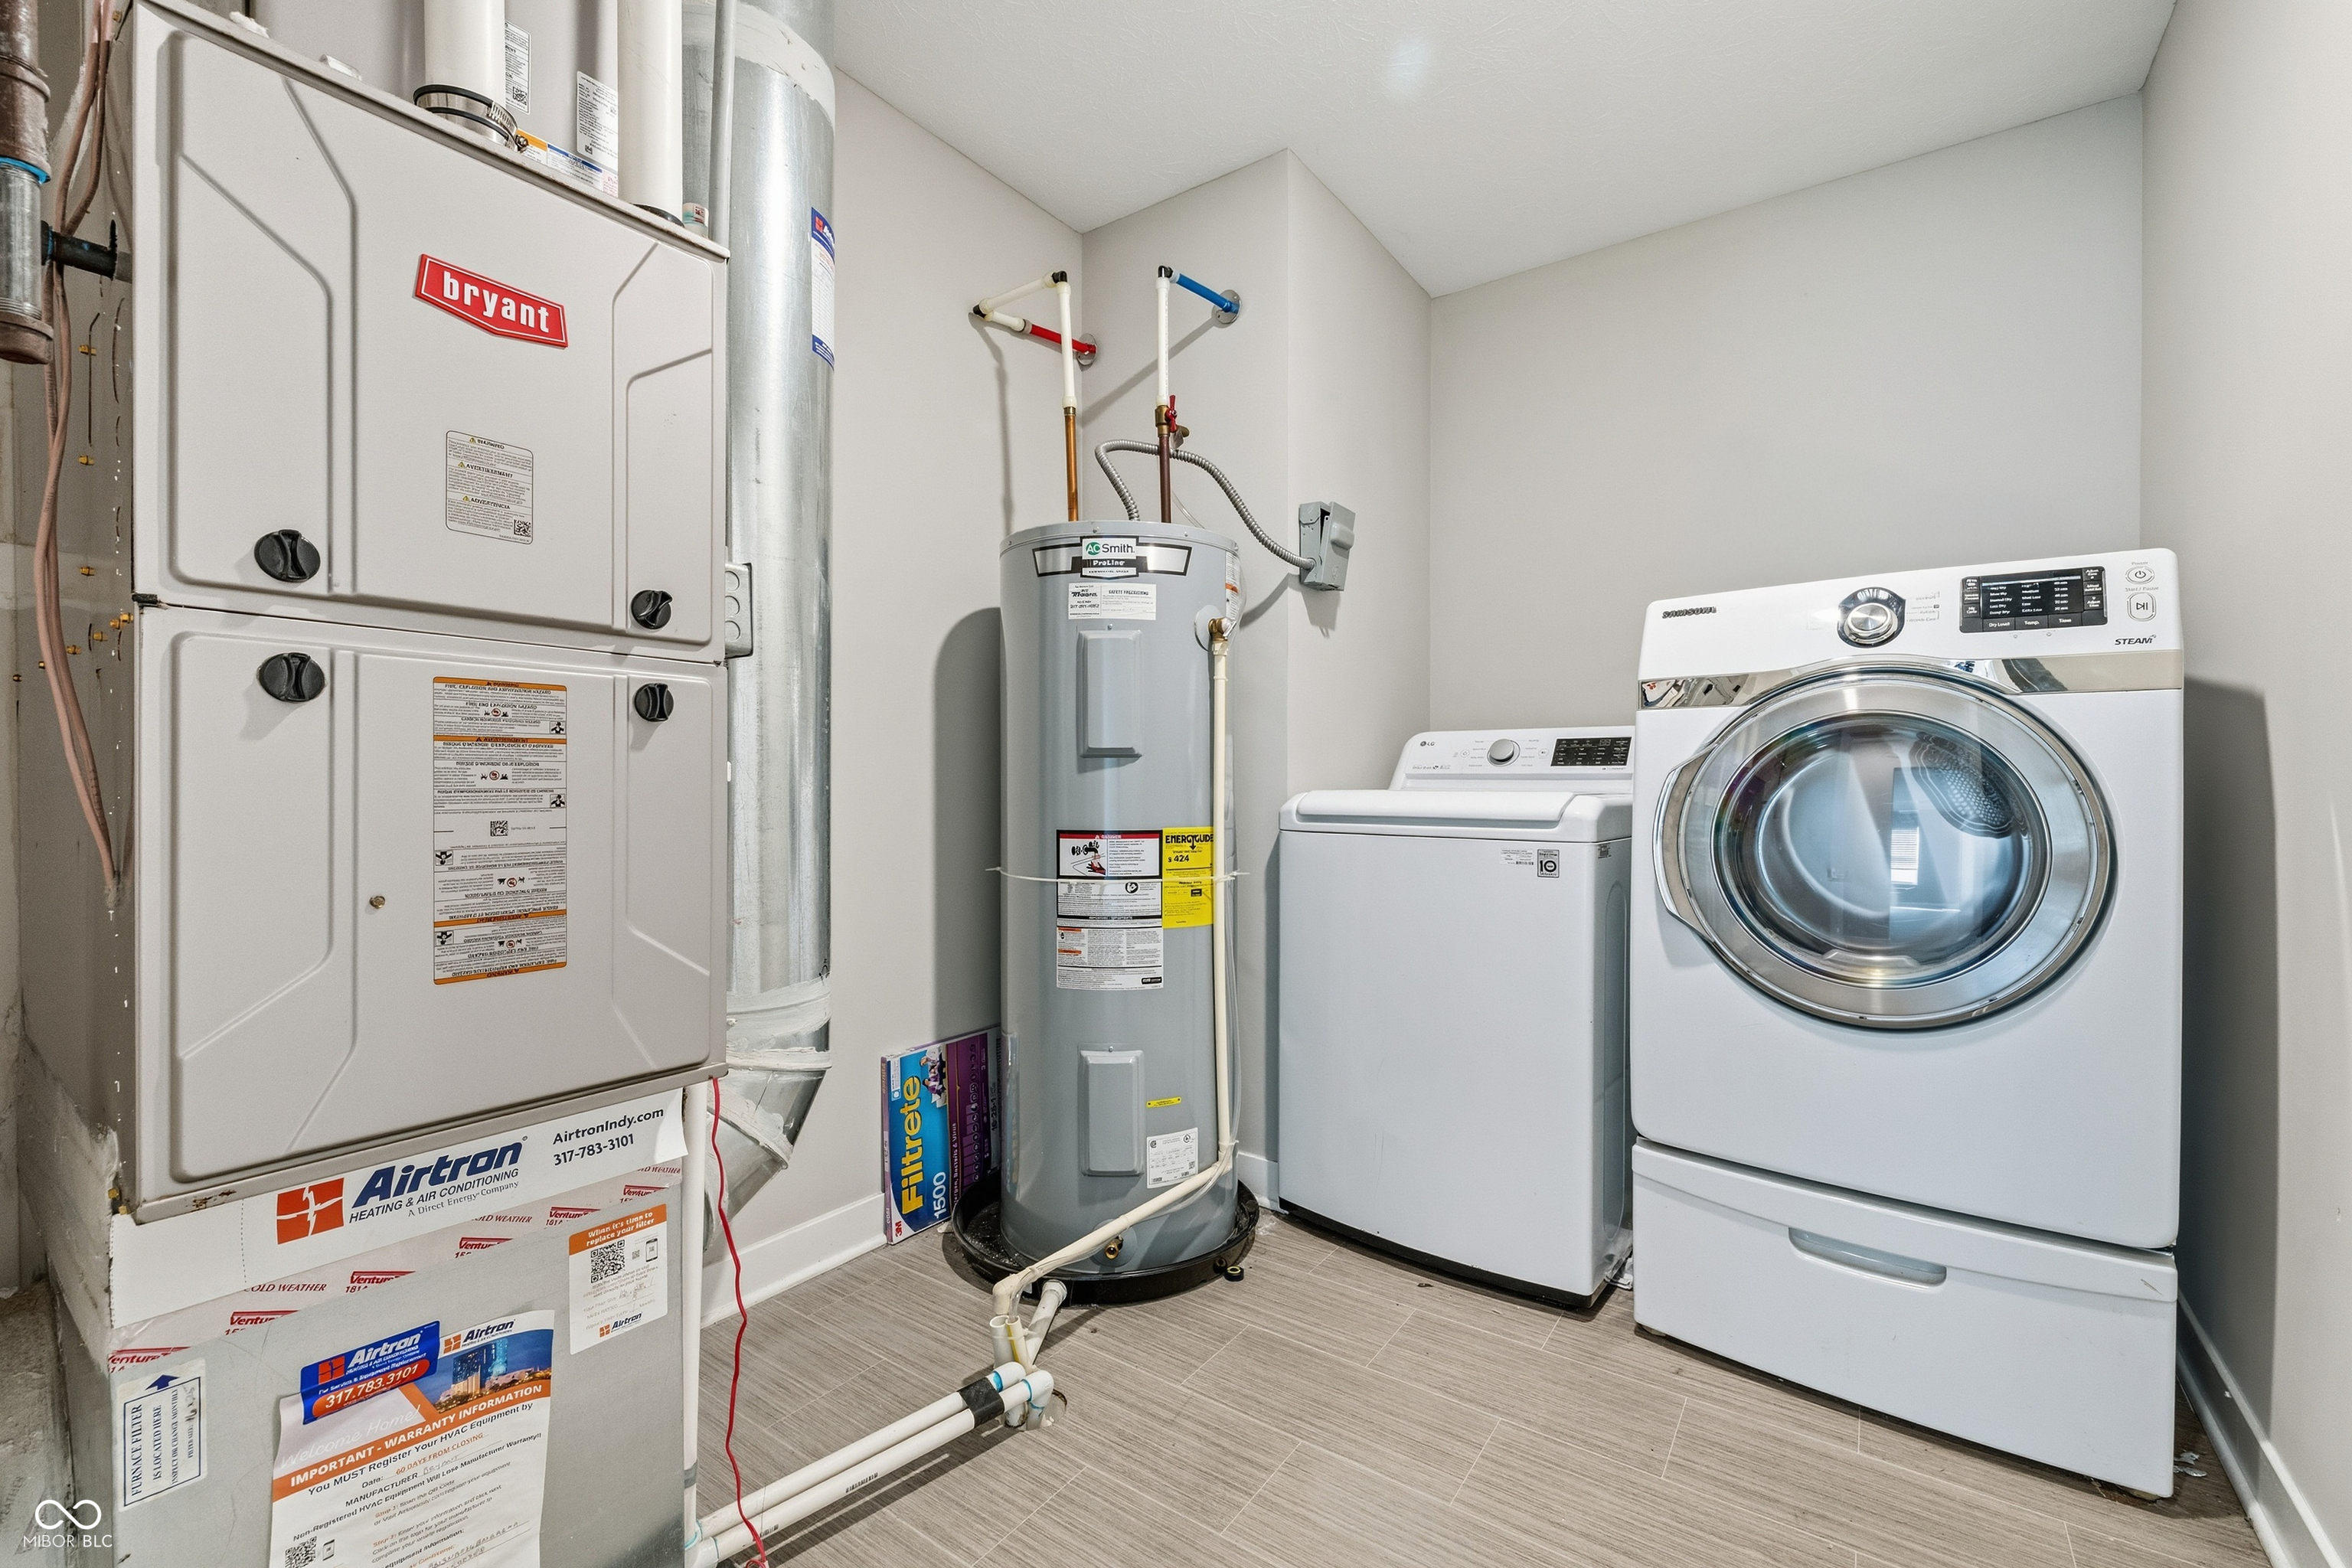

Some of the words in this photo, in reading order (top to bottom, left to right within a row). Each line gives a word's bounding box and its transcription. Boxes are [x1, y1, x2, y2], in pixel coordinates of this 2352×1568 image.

[443, 271, 549, 333] bryant
[1102, 543, 1133, 553] Smith
[2115, 637, 2153, 645] STEAM
[553, 1109, 664, 1145] AirtronIndy.com
[900, 1075, 924, 1215] Filtrete
[554, 1133, 634, 1166] 317-783-3101
[351, 1142, 523, 1209] Airtron
[349, 1200, 403, 1223] HEATING
[405, 1197, 413, 1207] &
[416, 1191, 436, 1204] AIR
[439, 1168, 519, 1197] CONDITIONING
[418, 1200, 445, 1214] Direct
[448, 1193, 477, 1207] Energy
[480, 1181, 519, 1197] Company
[933, 1171, 946, 1219] 1500
[616, 1227, 634, 1238] your
[895, 1220, 903, 1237] 3M
[277, 1283, 327, 1292] WEATHER
[463, 1321, 514, 1343] Airtron
[612, 1312, 642, 1330] Airtron
[348, 1333, 421, 1368] Airtron
[325, 1364, 419, 1409] 317.783.3101
[131, 1404, 142, 1444] FILTER
[153, 1404, 162, 1429] HERE
[153, 1430, 162, 1470] LOCATED
[281, 1430, 363, 1468] Welcome
[366, 1404, 421, 1437] Home!
[291, 1446, 374, 1487] IMPORTANT
[384, 1413, 456, 1449] WARRANTY
[459, 1384, 543, 1420] INFORMATION
[309, 1483, 330, 1496] You
[334, 1468, 367, 1487] MUST
[368, 1449, 412, 1473] Register
[414, 1439, 439, 1452] Your
[440, 1426, 469, 1442] HVAC
[470, 1406, 520, 1429] Equipment
[522, 1402, 534, 1411] by
[407, 1457, 428, 1470] DAYS
[429, 1447, 451, 1462] FROM
[452, 1432, 484, 1451] CLOSING
[131, 1445, 142, 1496] FURNACE
[153, 1472, 162, 1481] IS
[345, 1472, 418, 1508] MANUFACTURER
[359, 1498, 384, 1513] HVAC
